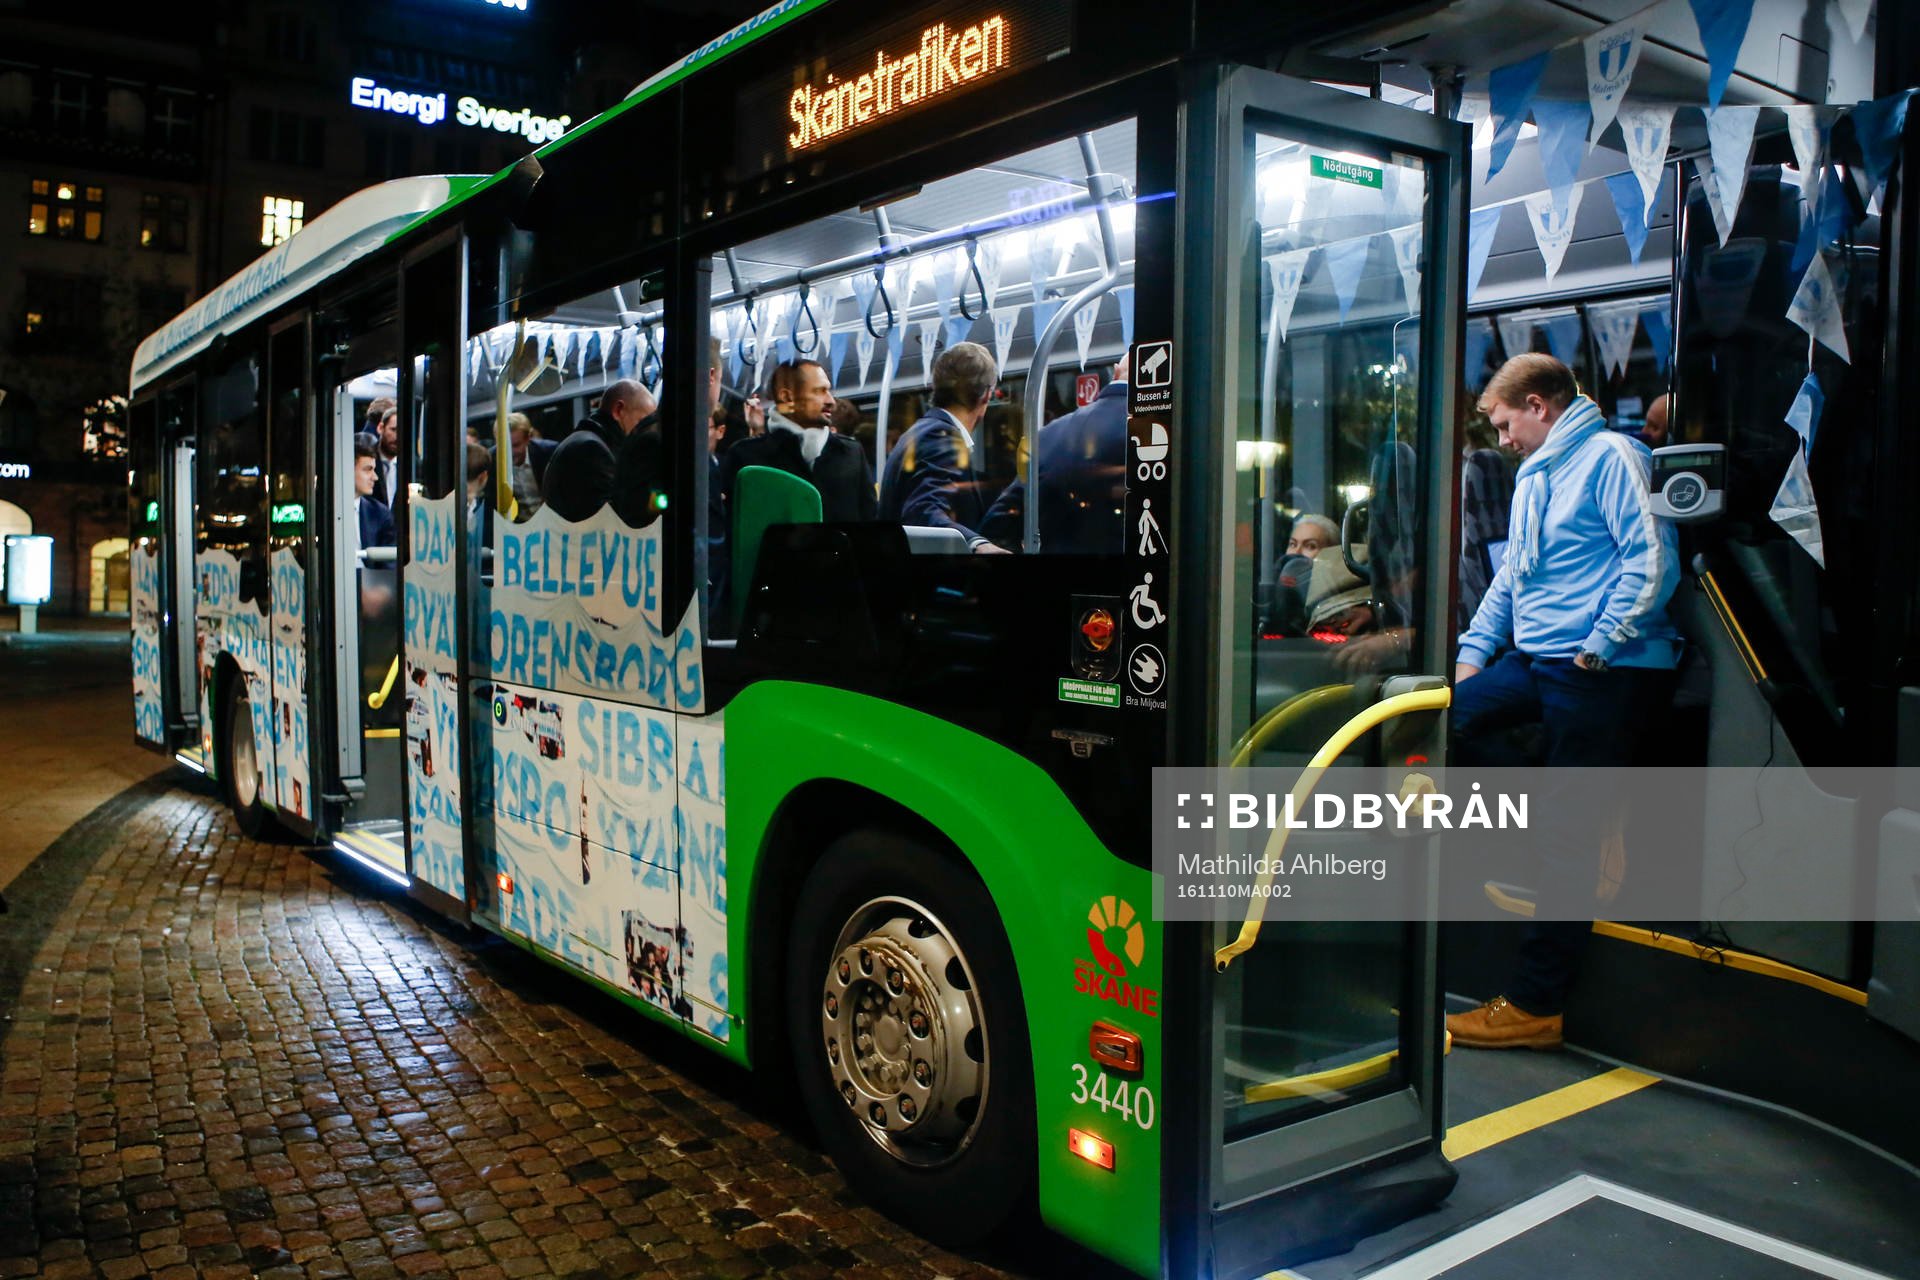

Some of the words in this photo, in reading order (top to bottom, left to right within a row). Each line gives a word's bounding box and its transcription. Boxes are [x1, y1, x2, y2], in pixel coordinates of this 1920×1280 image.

[351, 77, 446, 124] Energi
[788, 15, 1004, 148] Skånetrafiken
[1322, 159, 1374, 181] Nödutgång
[1136, 392, 1161, 402] Bussen
[1162, 389, 1171, 399] är
[502, 529, 657, 611] BELLEVUE
[404, 581, 457, 660] RVÄ
[1125, 695, 1139, 706] Bra
[1140, 697, 1167, 711] Miljöval
[1070, 1063, 1155, 1131] 3440
